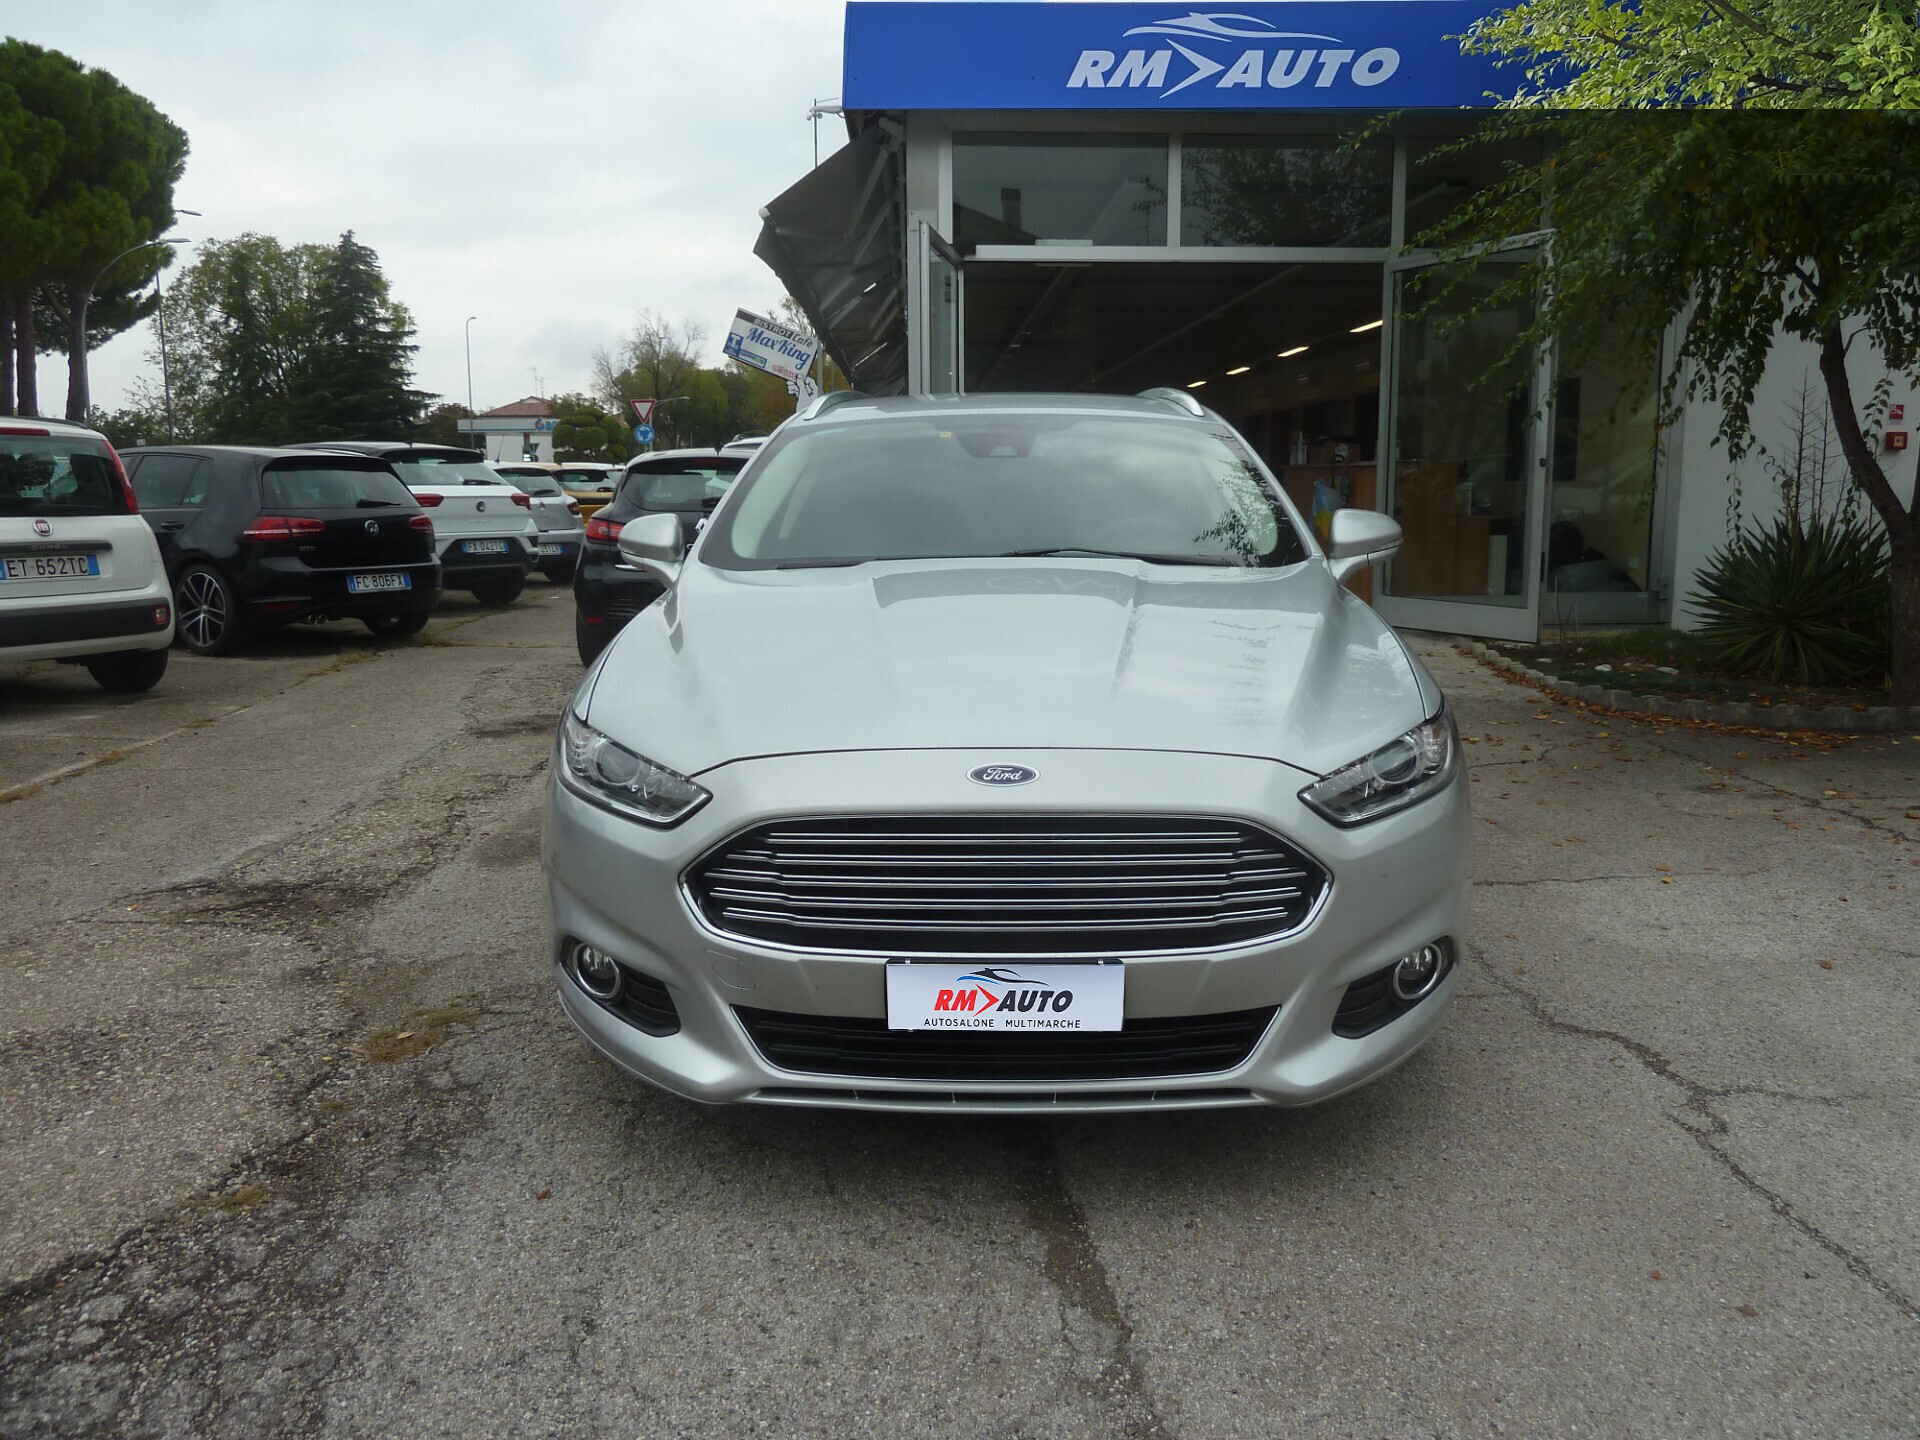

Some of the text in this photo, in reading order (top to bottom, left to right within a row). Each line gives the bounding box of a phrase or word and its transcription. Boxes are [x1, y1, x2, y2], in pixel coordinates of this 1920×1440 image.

[1215, 47, 1400, 89] AUTO
[753, 318, 793, 339] BISTROT
[6, 557, 88, 577] ET 652TC
[356, 574, 404, 588] FC 806FX
[983, 767, 1023, 781] Ford
[934, 989, 1073, 1013] RM AUTO
[923, 1017, 1081, 1029] AUTOSALONE MULTIMARCHE
